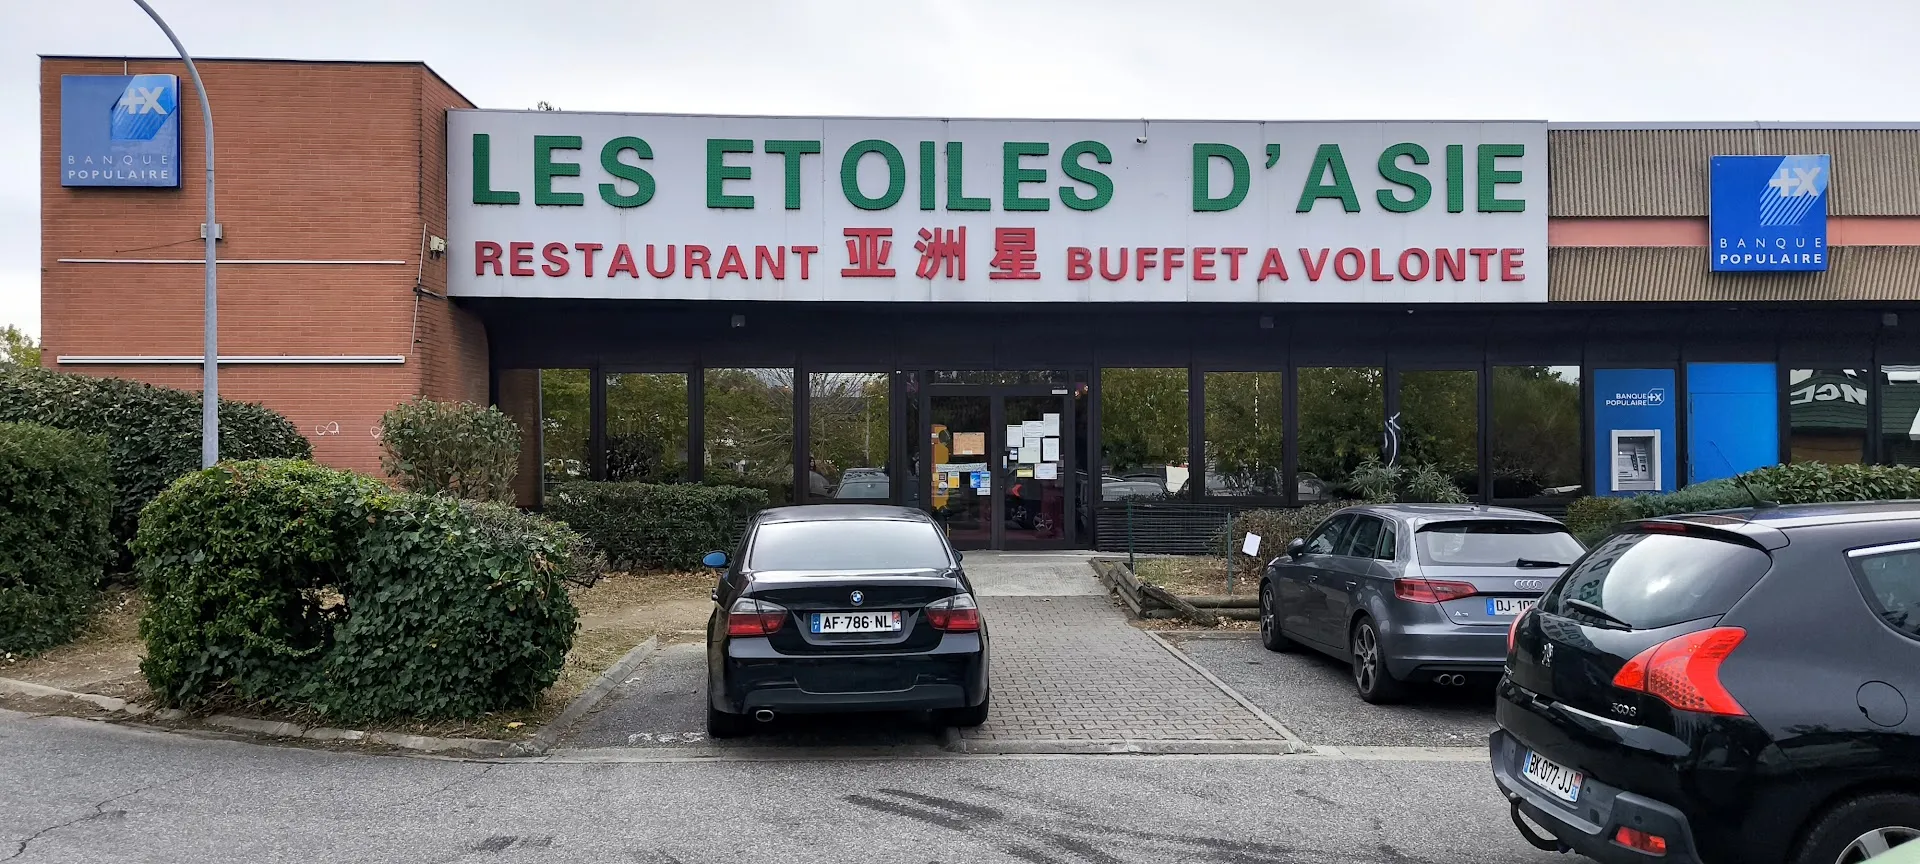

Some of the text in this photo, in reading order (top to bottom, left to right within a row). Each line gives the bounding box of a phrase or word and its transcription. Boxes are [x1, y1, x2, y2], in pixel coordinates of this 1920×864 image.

[68, 155, 168, 165] BANQUE
[472, 133, 657, 208] LES
[705, 138, 1115, 212] ETOILES
[68, 169, 169, 180] POPULAIRE
[840, 226, 1042, 282] 亚洲星
[1720, 237, 1822, 249] BANQUE
[475, 240, 819, 281] RESTAURANT
[1066, 247, 1526, 283] BUFFET A VOLONTE
[1720, 253, 1822, 265] POPULAIRE
[823, 615, 892, 630] AF-786-NL
[1529, 753, 1574, 794] BK-077-JJ
